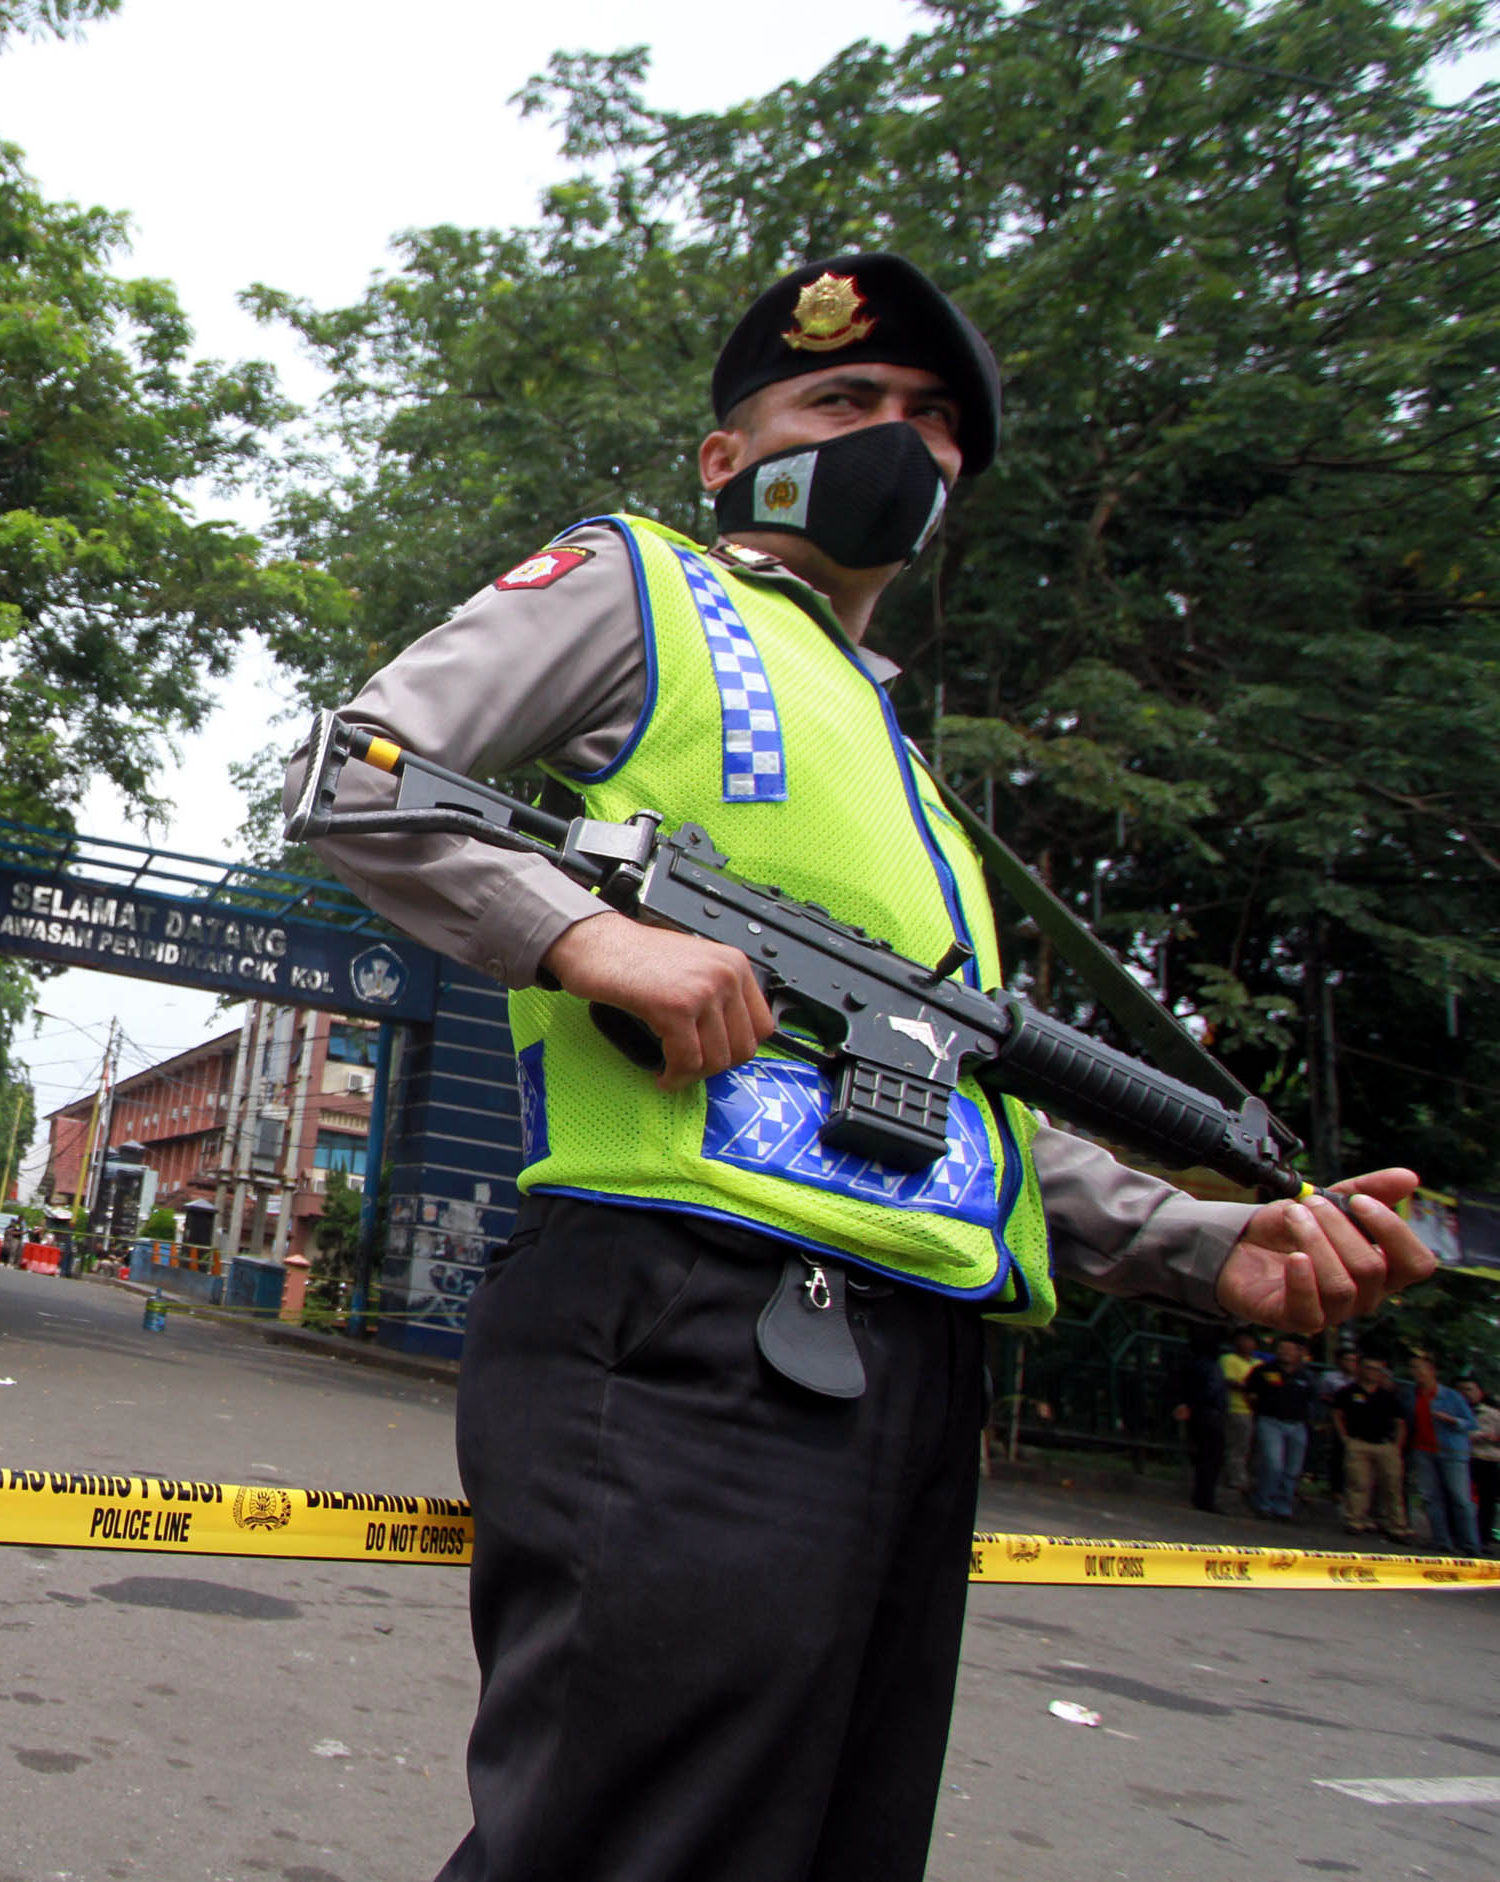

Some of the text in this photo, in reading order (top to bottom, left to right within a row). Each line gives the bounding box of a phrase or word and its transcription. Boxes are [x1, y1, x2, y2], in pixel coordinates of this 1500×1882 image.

[12, 882, 288, 957] SELAMAT DATANG
[98, 932, 234, 974] PENDIDIKAN
[90, 1507, 193, 1543] POLICE LINE
[365, 1522, 465, 1555] DO NOT CROSS
[970, 1551, 983, 1574] NE
[1084, 1554, 1145, 1578] DO NOT CROSS
